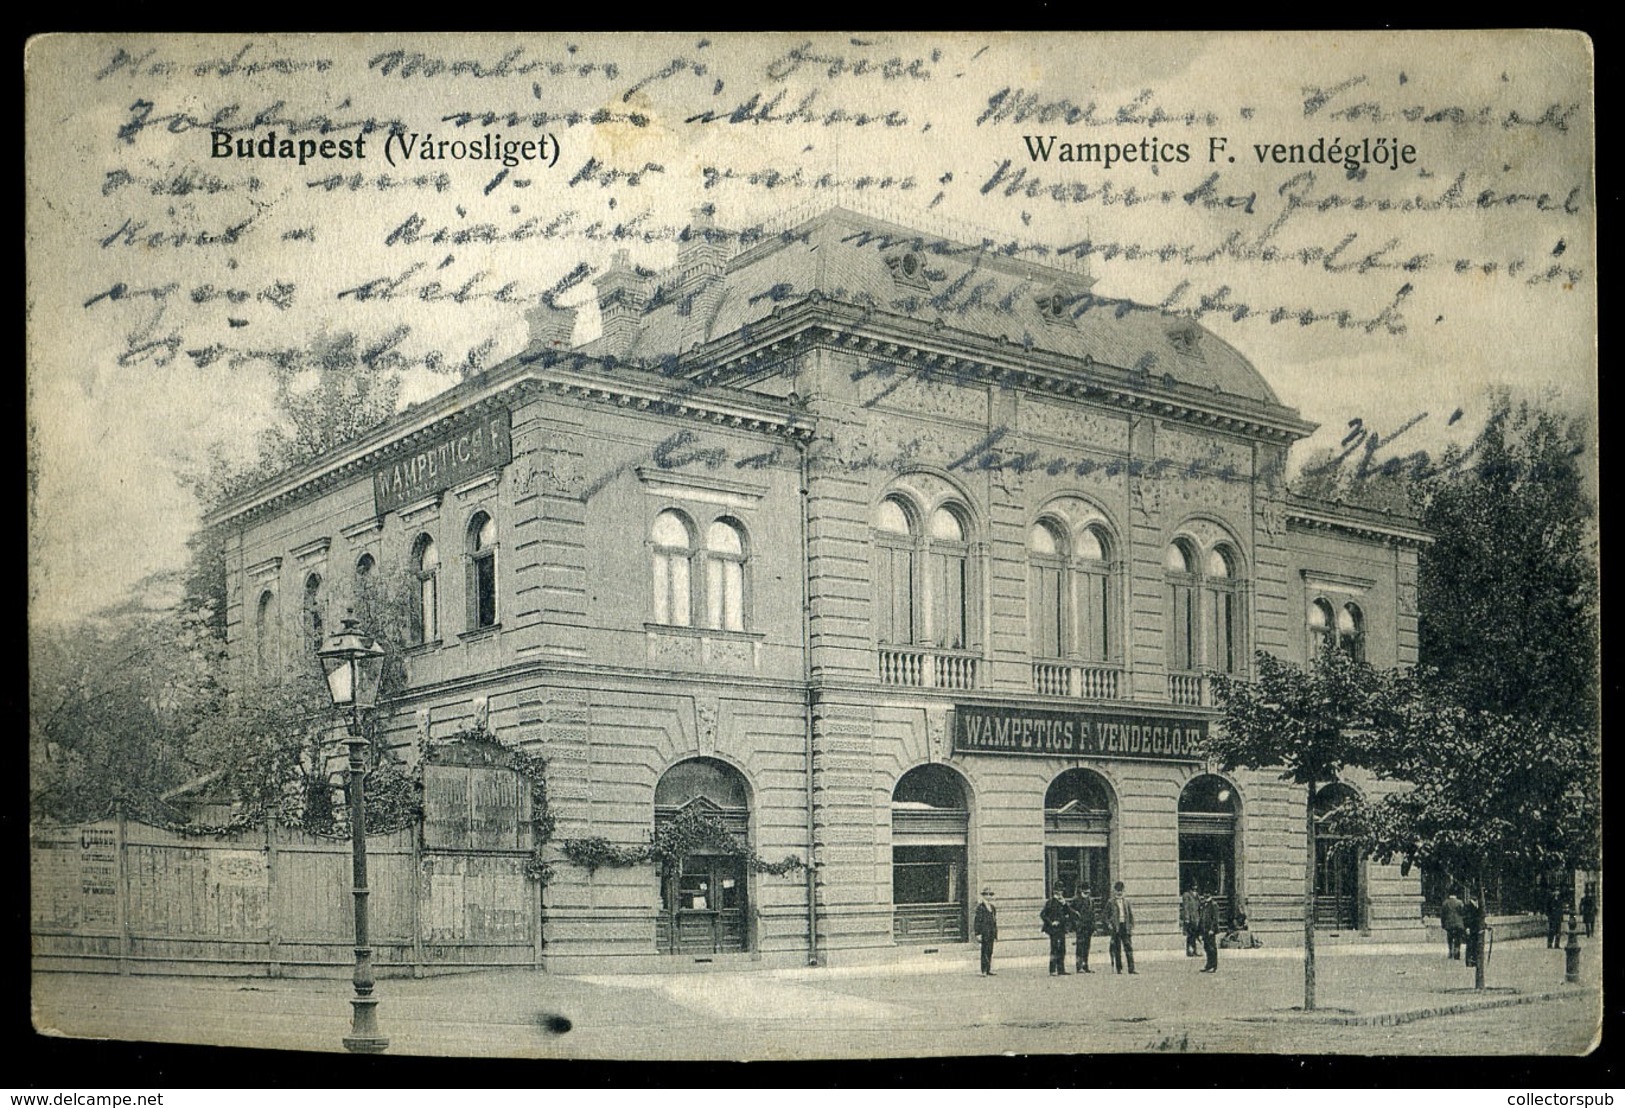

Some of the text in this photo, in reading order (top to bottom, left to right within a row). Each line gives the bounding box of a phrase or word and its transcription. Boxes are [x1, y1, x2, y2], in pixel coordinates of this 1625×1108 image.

[211, 131, 560, 167] Budapest (Városliget)
[1023, 137, 1417, 169] Wampetics F. vendéglője
[378, 427, 483, 498] WAMPETICS
[965, 714, 1074, 750] WAMPETICS
[1079, 721, 1093, 751] F.
